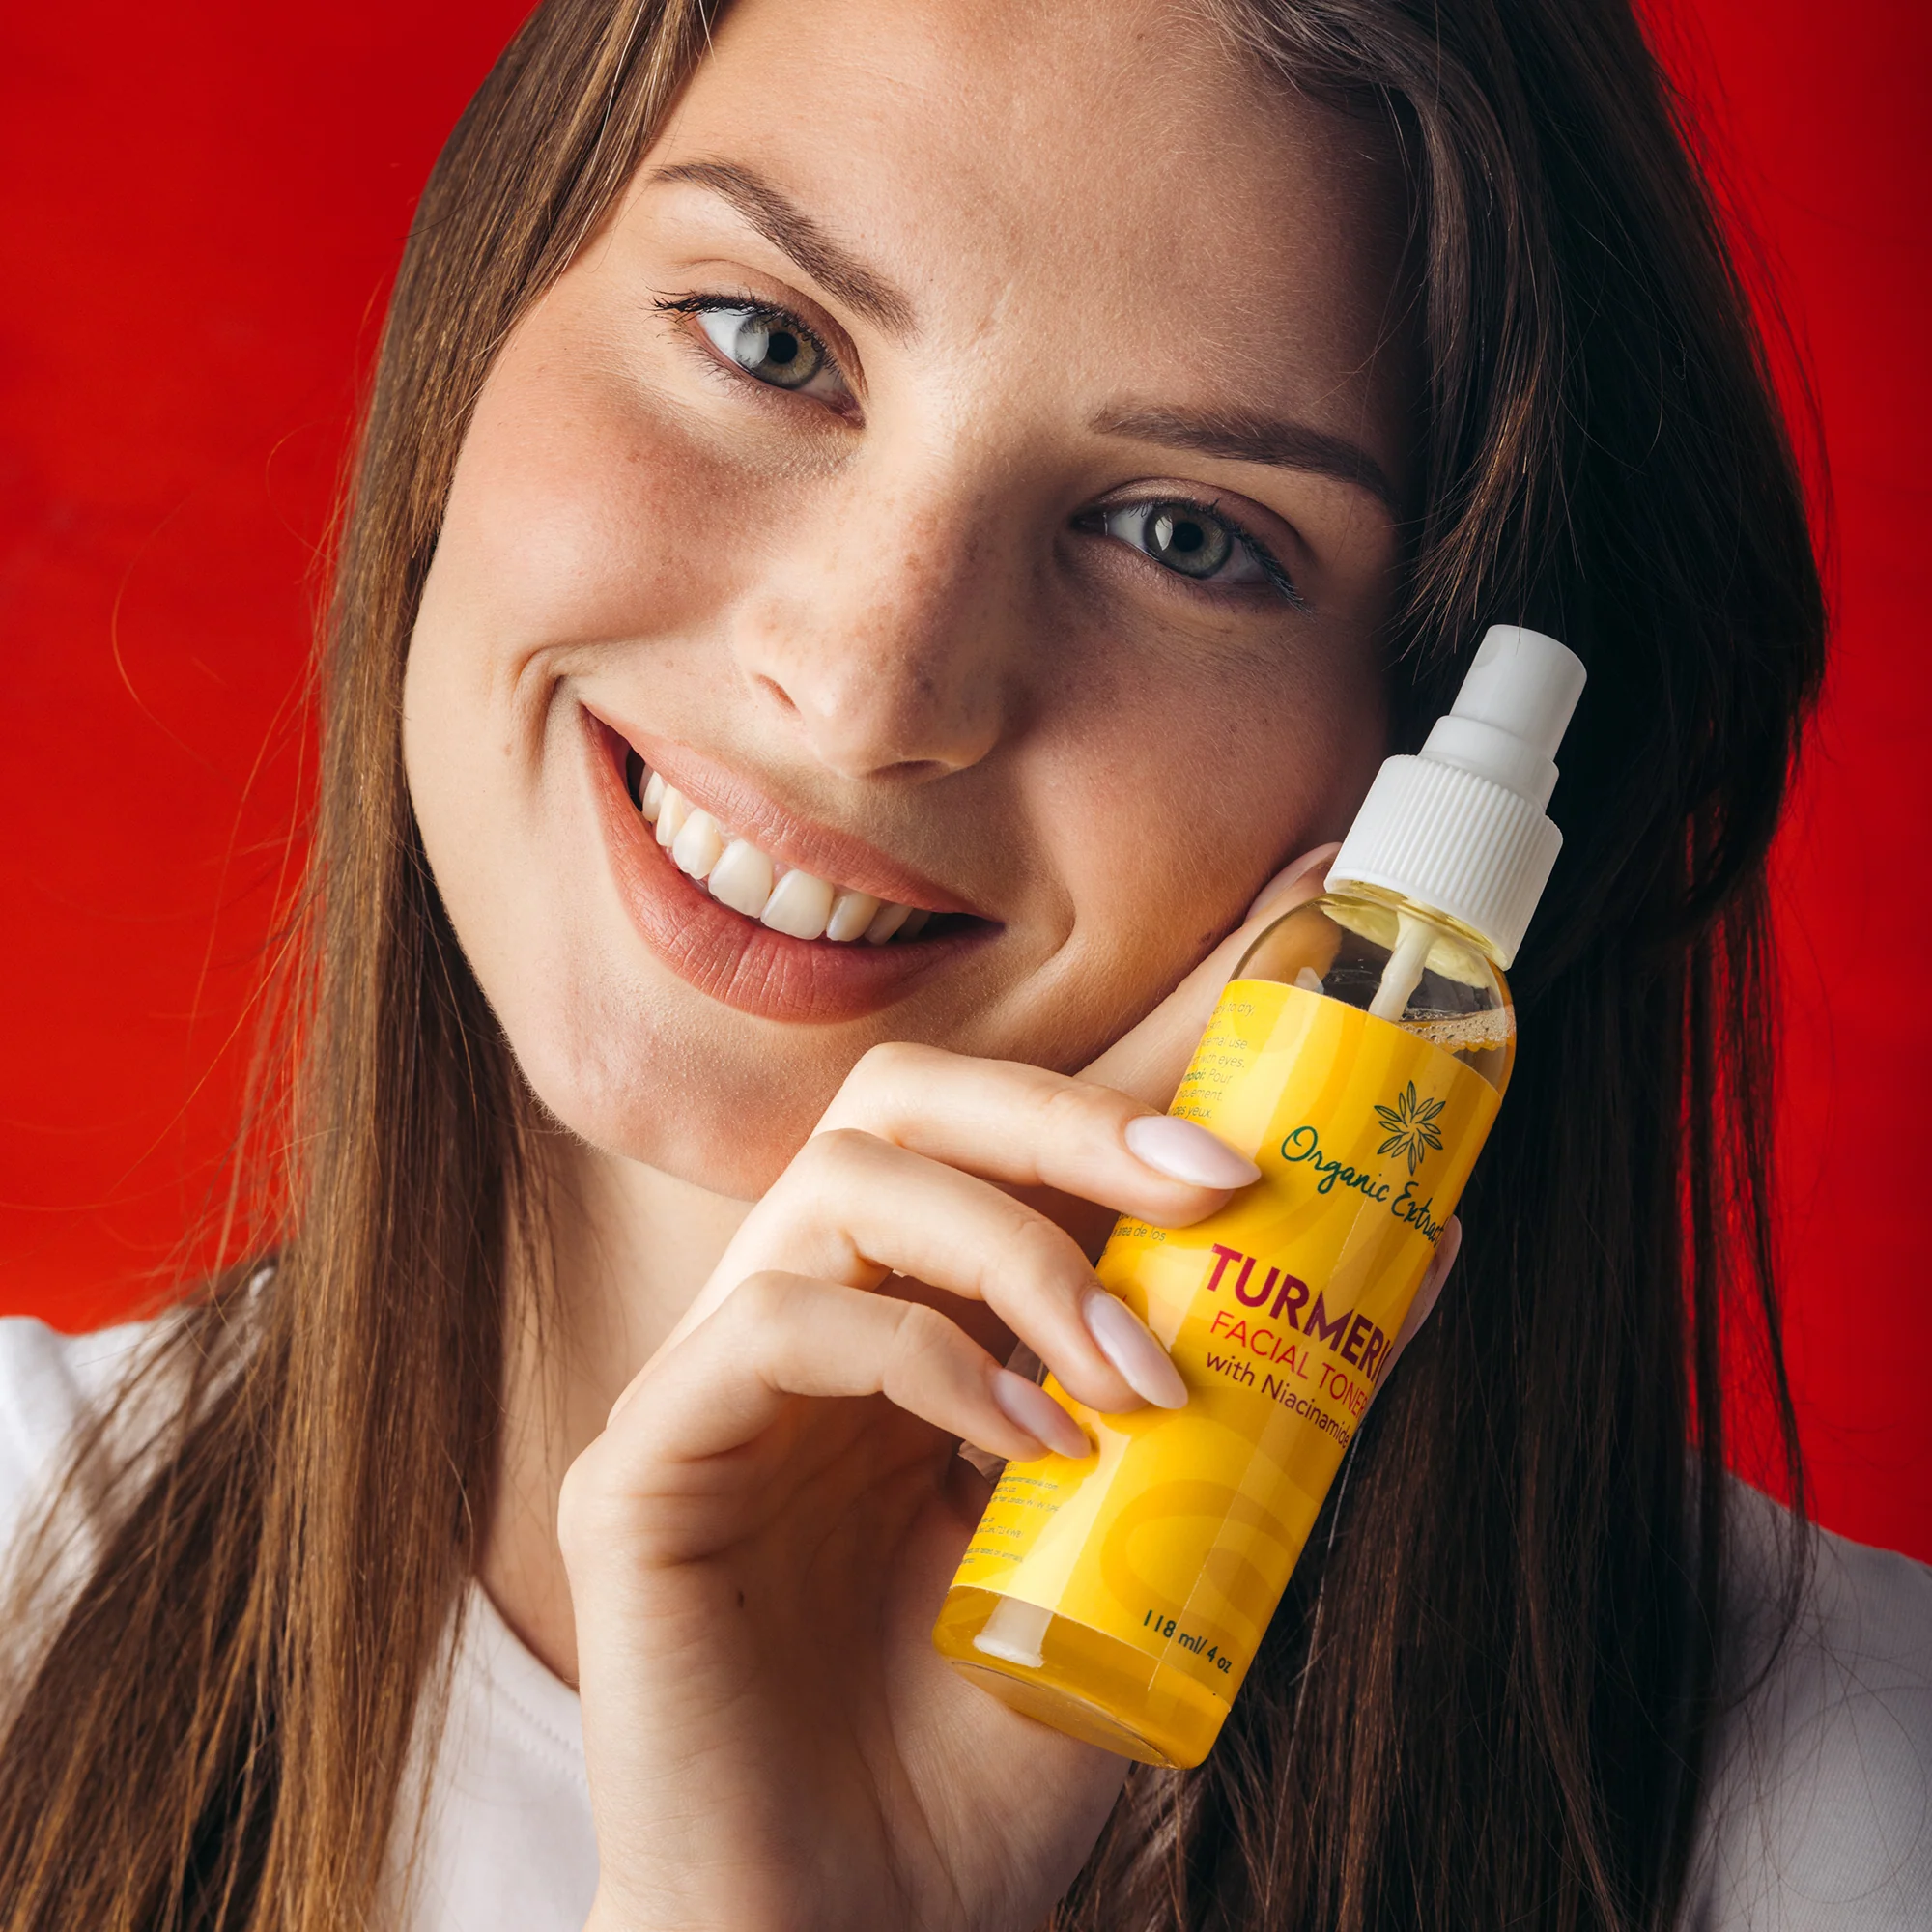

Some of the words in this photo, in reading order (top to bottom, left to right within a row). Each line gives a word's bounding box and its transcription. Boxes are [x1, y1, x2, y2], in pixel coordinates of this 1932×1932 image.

[1228, 1003, 1236, 1012] to
[1237, 1000, 1255, 1016] dry,
[1229, 1040, 1248, 1050] use
[1218, 1055, 1245, 1068] eyes.
[1208, 1068, 1233, 1084] Pour
[1187, 1106, 1213, 1119] yeux.
[1281, 1126, 1389, 1202] Organic
[1133, 1224, 1148, 1237] de
[1149, 1226, 1166, 1241] los
[1210, 1310, 1309, 1379] FACIAL
[1207, 1352, 1256, 1386] with
[1261, 1374, 1349, 1449] Niacinamide
[1144, 1609, 1177, 1638] 118
[1178, 1633, 1208, 1655] ml/
[1207, 1646, 1218, 1662] 4
[1217, 1657, 1232, 1674] oz
